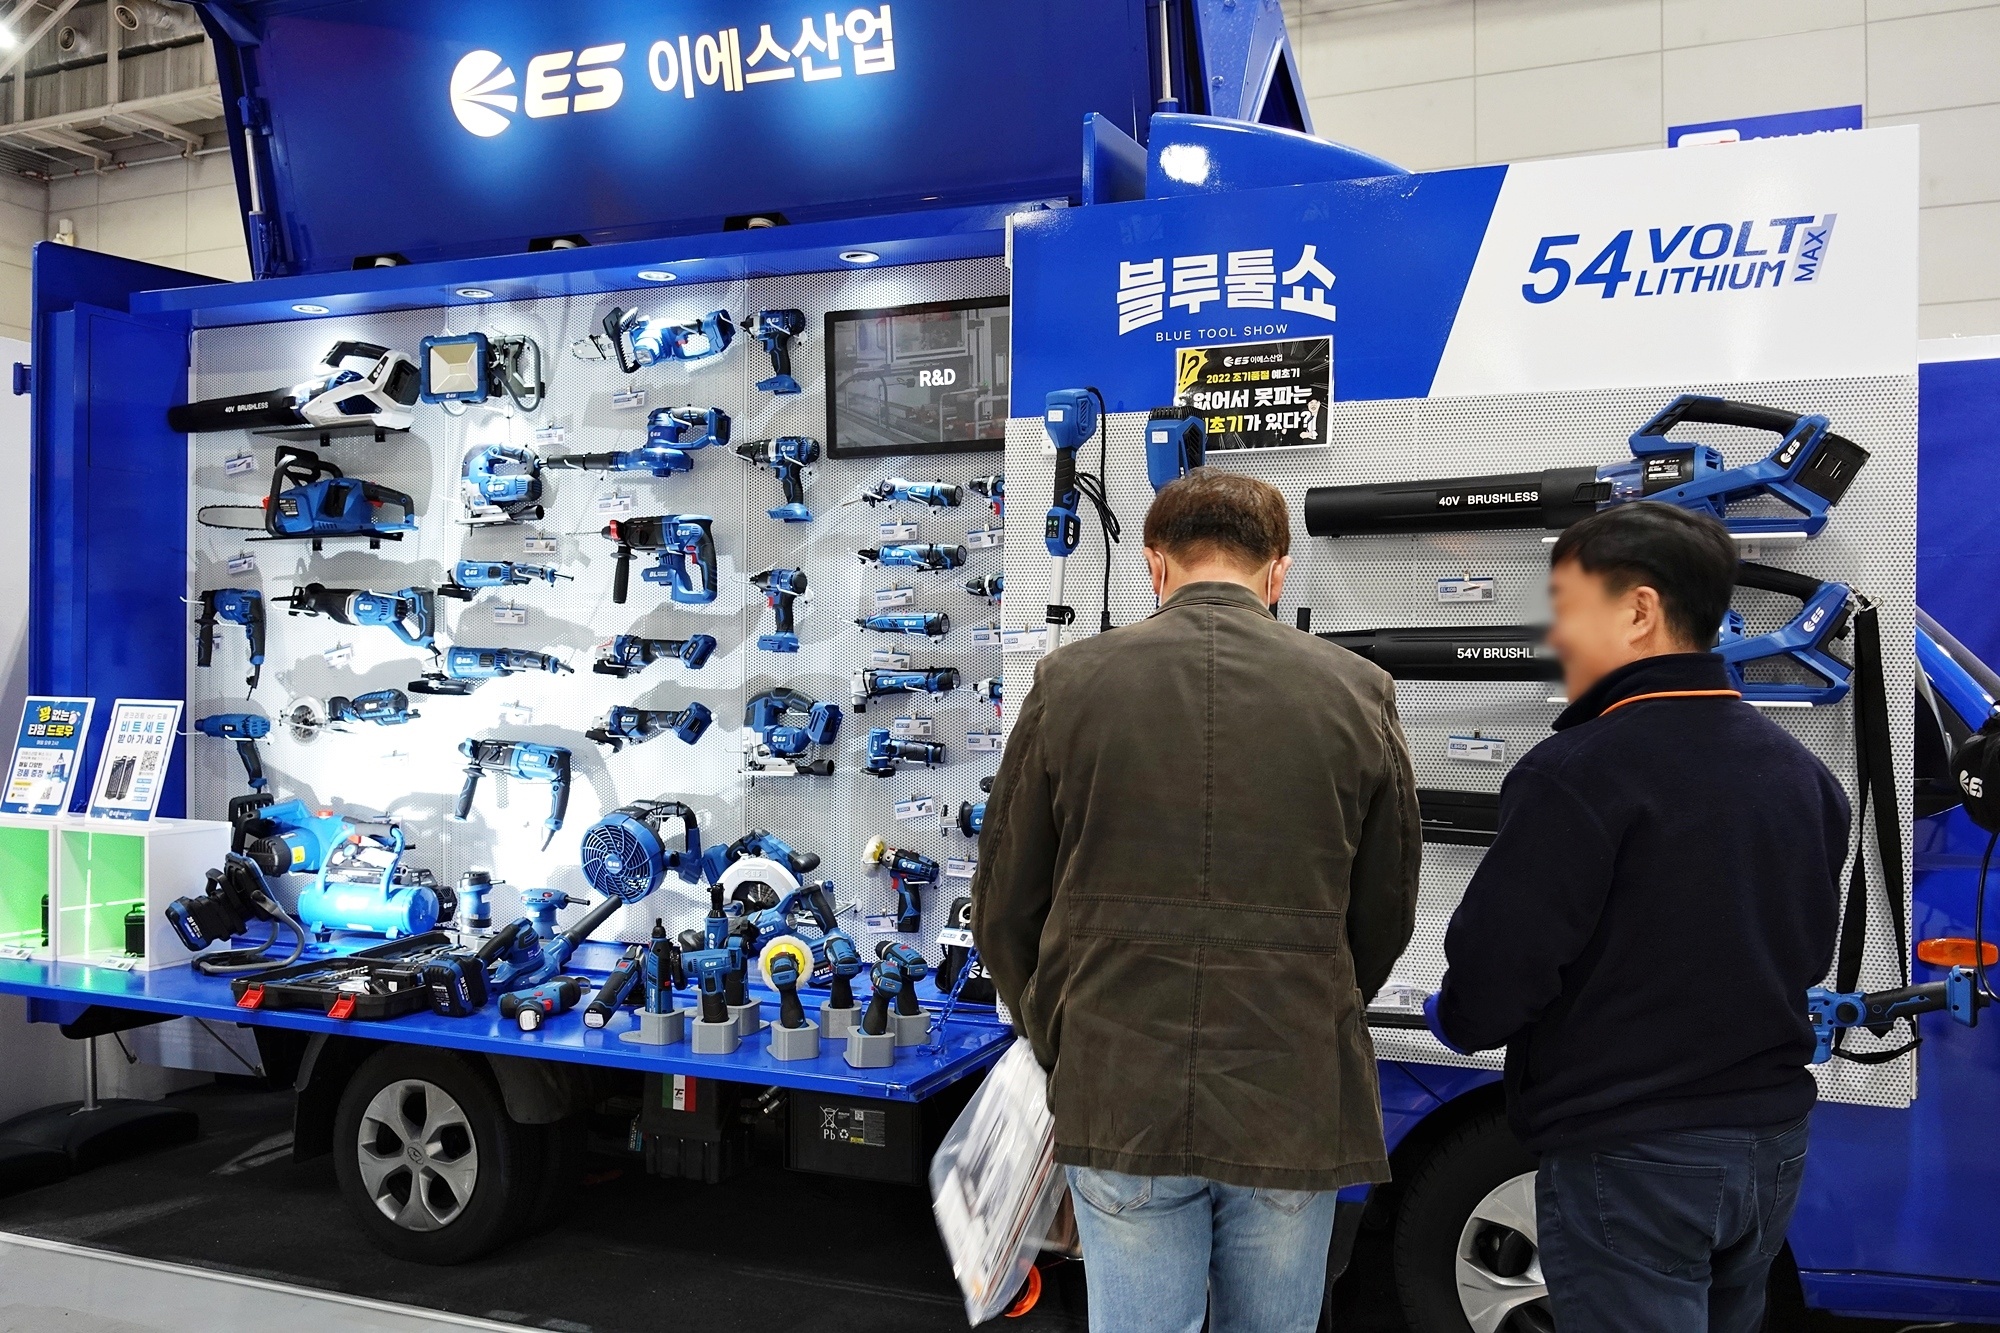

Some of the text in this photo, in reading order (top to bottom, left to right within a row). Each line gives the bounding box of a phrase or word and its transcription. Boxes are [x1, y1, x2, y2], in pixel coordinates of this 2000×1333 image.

[525, 4, 896, 119] ES 이에스산업
[1648, 215, 1816, 264] VOLT
[1793, 228, 1829, 283] MAX
[1521, 229, 1634, 305] 54
[1634, 259, 1787, 297] LITHIUM
[1116, 244, 1337, 336] 블루툴쇼
[1155, 323, 1289, 342] BLUE TOOL SHOW
[1250, 353, 1283, 364] 이에스산업
[918, 367, 957, 388] R&D
[1206, 373, 1231, 385] 2022
[1193, 385, 1313, 411] 없어서 못파는
[1265, 410, 1313, 431] 있다?
[1788, 439, 1801, 456] ES
[1438, 491, 1539, 507] 40V BRUSHLESS
[1811, 607, 1825, 624] ES
[1456, 647, 1481, 659] 54V
[27, 723, 47, 736] 타임
[823, 1128, 836, 1140] Pb
